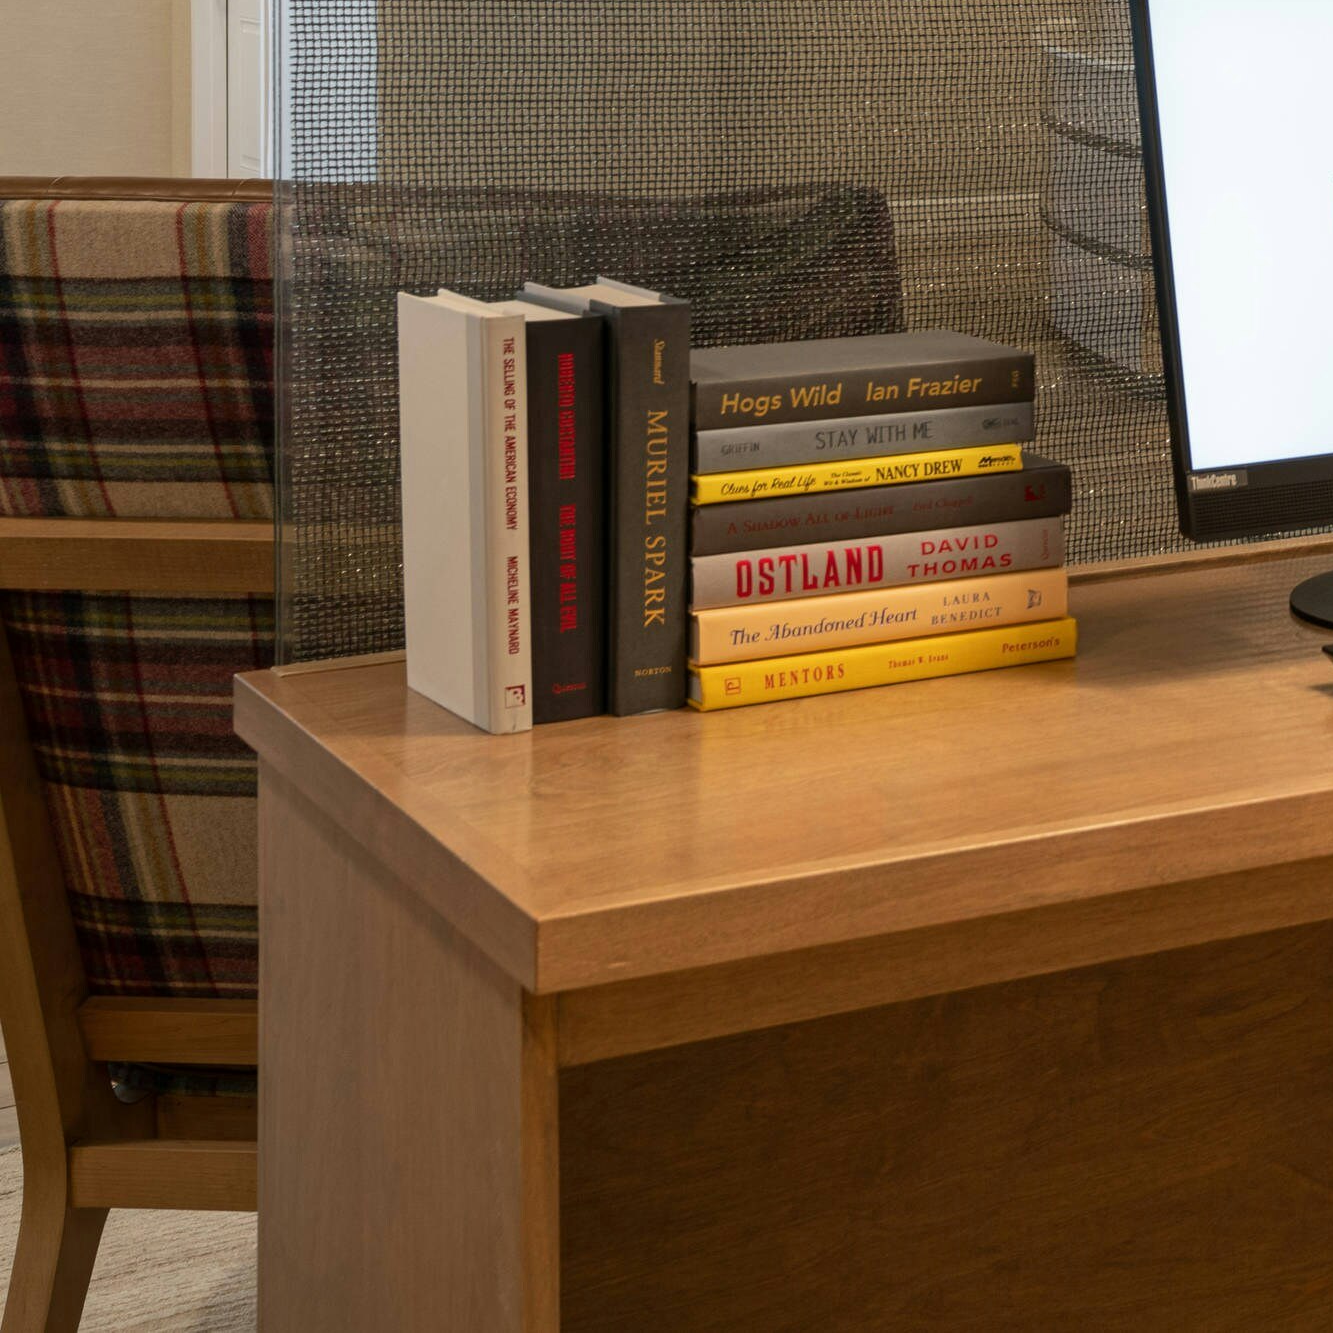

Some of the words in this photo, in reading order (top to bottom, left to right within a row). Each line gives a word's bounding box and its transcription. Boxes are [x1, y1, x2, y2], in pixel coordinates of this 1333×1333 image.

[503, 337, 515, 354] THE
[504, 358, 516, 396] SELLING
[504, 399, 516, 410] OF
[720, 392, 782, 417] Hogs
[790, 382, 842, 407] Wild
[865, 381, 898, 402] Ian
[906, 374, 983, 398] Frazier
[504, 414, 516, 432] THE
[815, 428, 858, 450] STAY
[866, 424, 906, 445] WITH
[913, 420, 934, 440] ME
[505, 435, 517, 484] AMERICAN
[720, 442, 760, 456] GRIFFIN
[646, 410, 668, 525] MURIEL
[875, 463, 921, 482] NANCY
[923, 459, 963, 477] DREW
[720, 482, 750, 496] Clues
[750, 480, 769, 498] for
[770, 477, 795, 492] Real
[797, 474, 816, 492] Life
[505, 486, 518, 531] ECONOMY
[727, 521, 737, 535] A
[921, 534, 998, 556] DAVID
[736, 545, 883, 598] OSTLAND
[907, 553, 1012, 578] THOMAS
[507, 556, 520, 604] MICHELINE
[643, 536, 667, 627] SPARK
[943, 591, 990, 607] LAURA
[730, 627, 760, 646] The
[764, 612, 867, 641] Abandoned
[868, 607, 918, 627] Heart
[931, 606, 1003, 625] BENEDICT
[508, 608, 520, 655] MAYNARD
[1002, 637, 1061, 654] Peterson's
[634, 666, 672, 677] NORTON
[888, 658, 915, 669] Thomas
[764, 663, 845, 690] MENTORS
